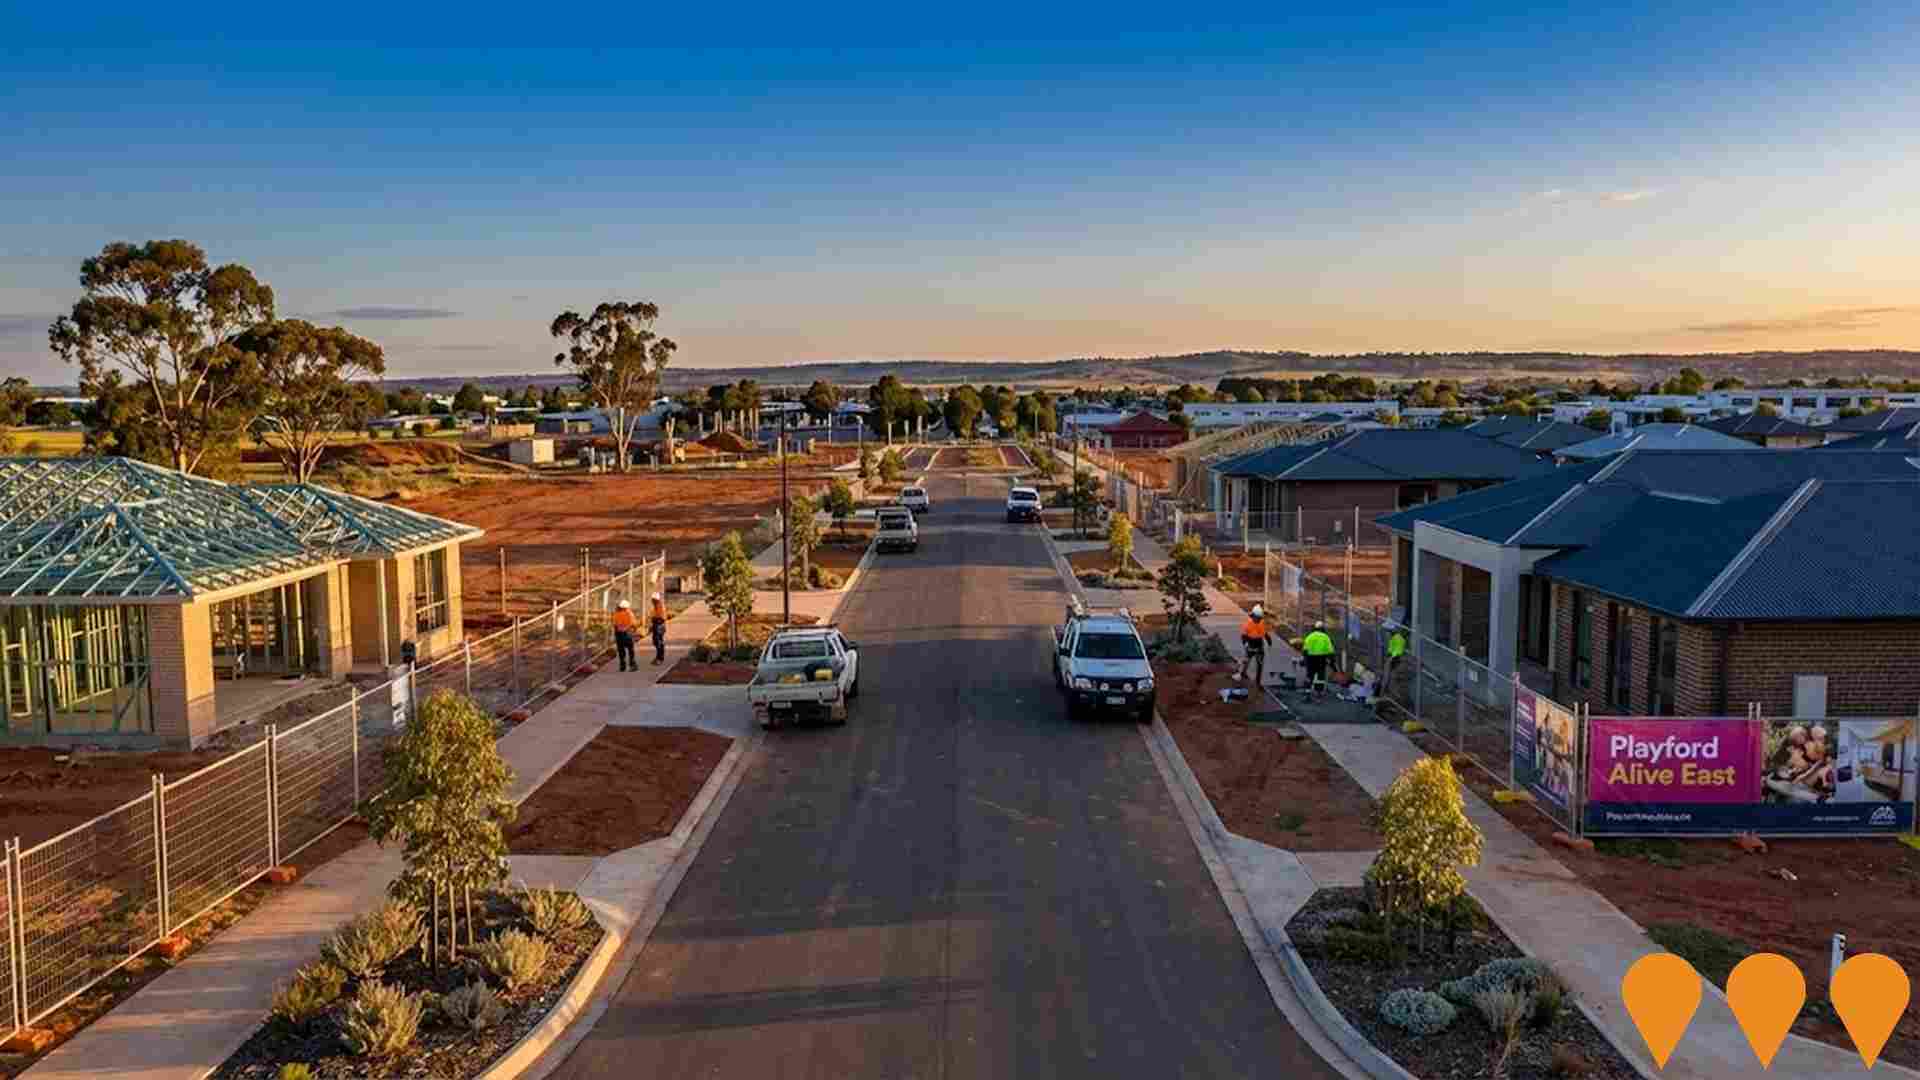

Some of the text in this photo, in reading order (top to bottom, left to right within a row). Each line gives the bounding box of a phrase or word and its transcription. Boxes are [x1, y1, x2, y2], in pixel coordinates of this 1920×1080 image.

[1610, 735, 1718, 763] Playford
[1608, 763, 1736, 786] Alive East
